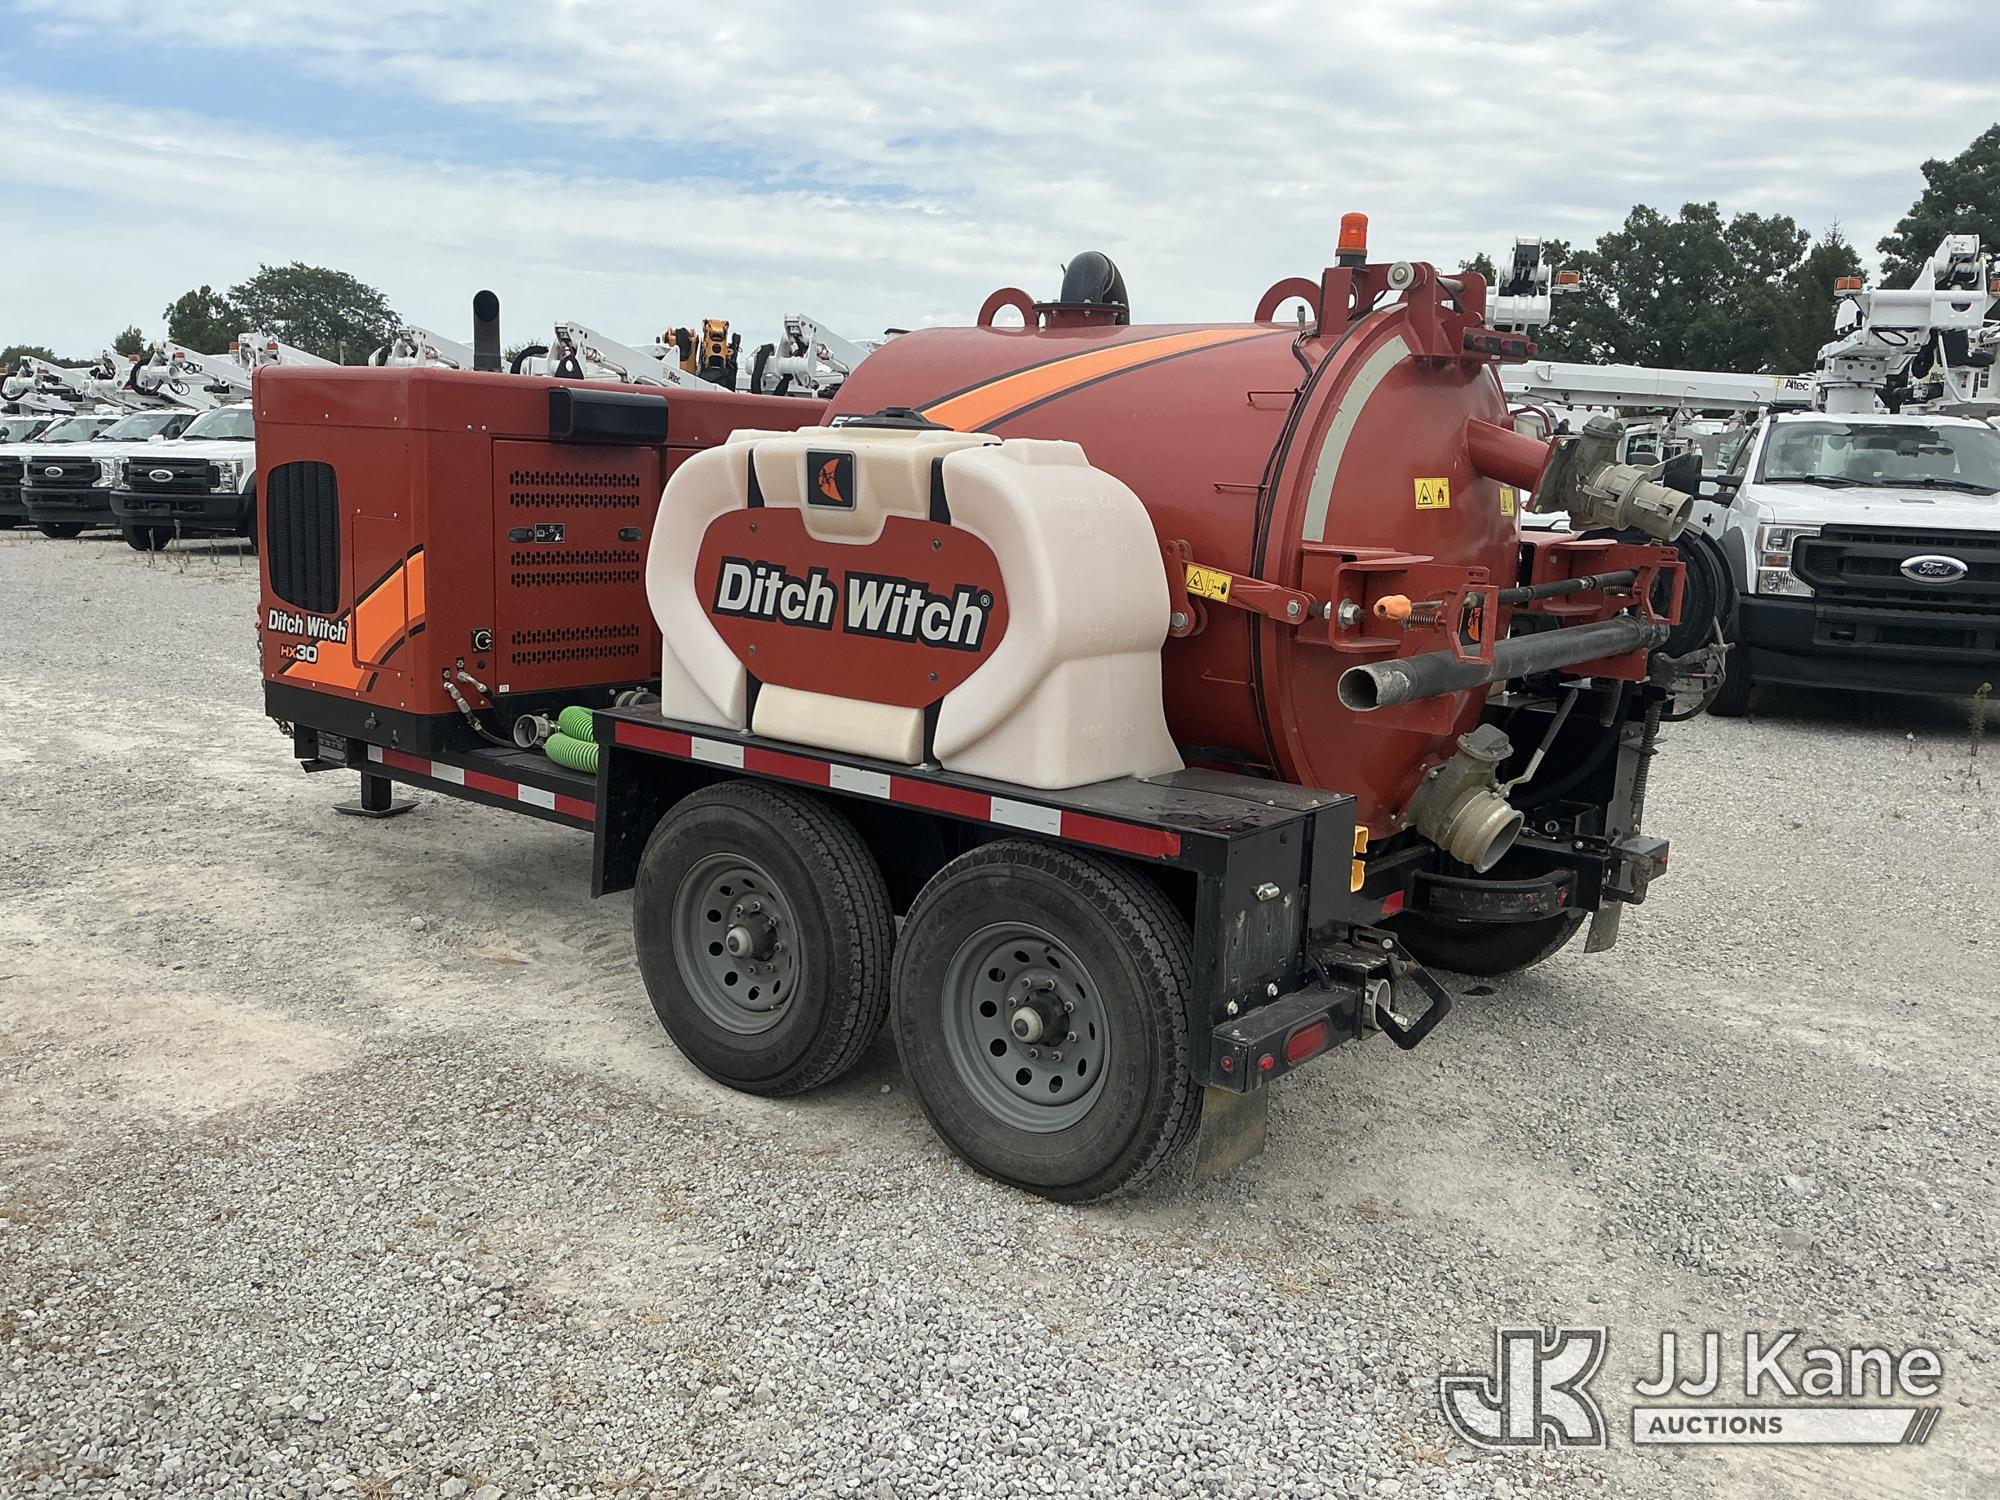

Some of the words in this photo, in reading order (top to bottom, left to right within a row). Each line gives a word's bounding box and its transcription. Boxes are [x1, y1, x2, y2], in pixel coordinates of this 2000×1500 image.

[1784, 379, 1809, 391] Altec
[1918, 561, 1951, 576] Ford
[717, 562, 834, 624] Ditch
[268, 609, 304, 635] Ditch
[307, 615, 348, 643] Witch
[281, 644, 318, 663] HX30
